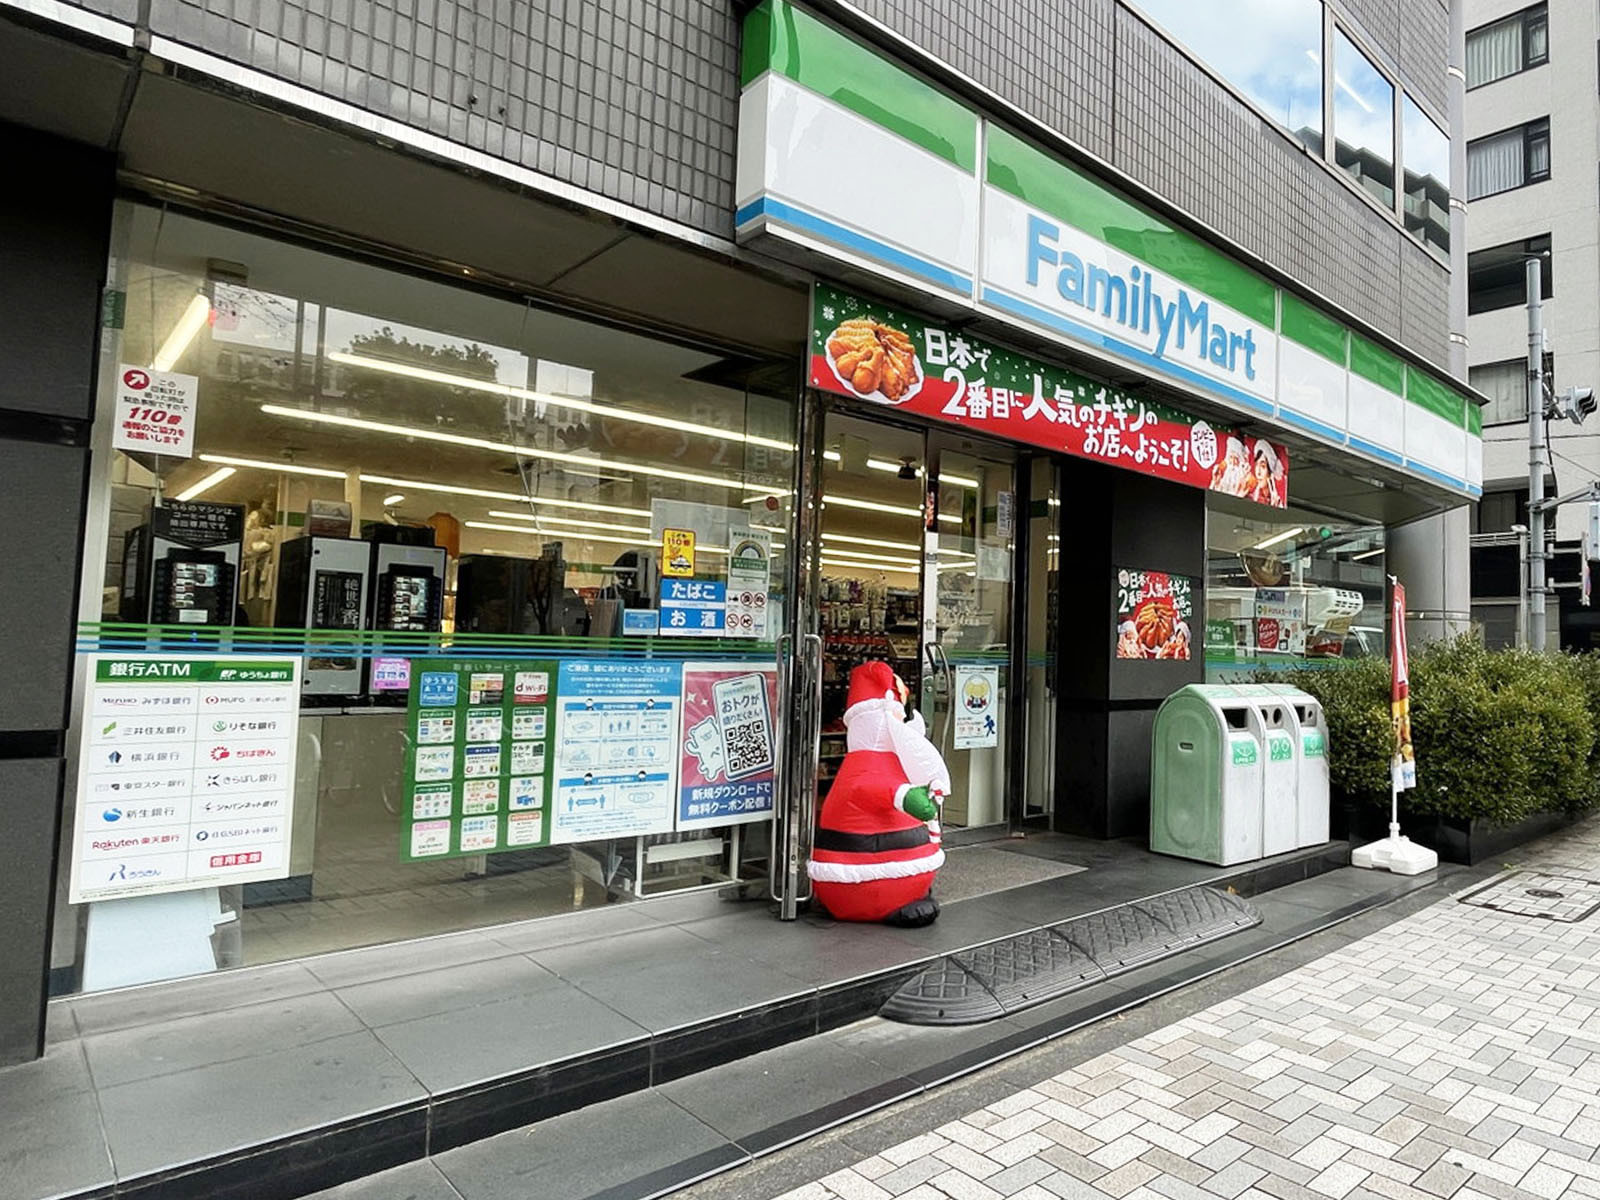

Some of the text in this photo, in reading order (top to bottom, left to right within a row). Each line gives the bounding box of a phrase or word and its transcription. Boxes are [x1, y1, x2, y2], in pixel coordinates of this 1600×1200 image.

[1025, 213, 1256, 380] FamilyMart
[924, 327, 992, 372] 日本で
[159, 380, 176, 388] この
[941, 366, 1158, 432] 2番目に人気のチキンの
[129, 407, 182, 425] 110番
[671, 582, 716, 599] たばこ
[670, 610, 716, 627] お酒
[109, 662, 191, 677] 銀行ATM
[239, 670, 288, 680] ゆうちょ銀行
[123, 726, 187, 736] 三井住友銀行
[229, 721, 276, 731] りそな銀行
[131, 751, 180, 762] 横浜銀行
[691, 782, 771, 801] 新規ダウンロードで
[126, 807, 175, 819] 新生銀行
[92, 838, 139, 851] Rakuten
